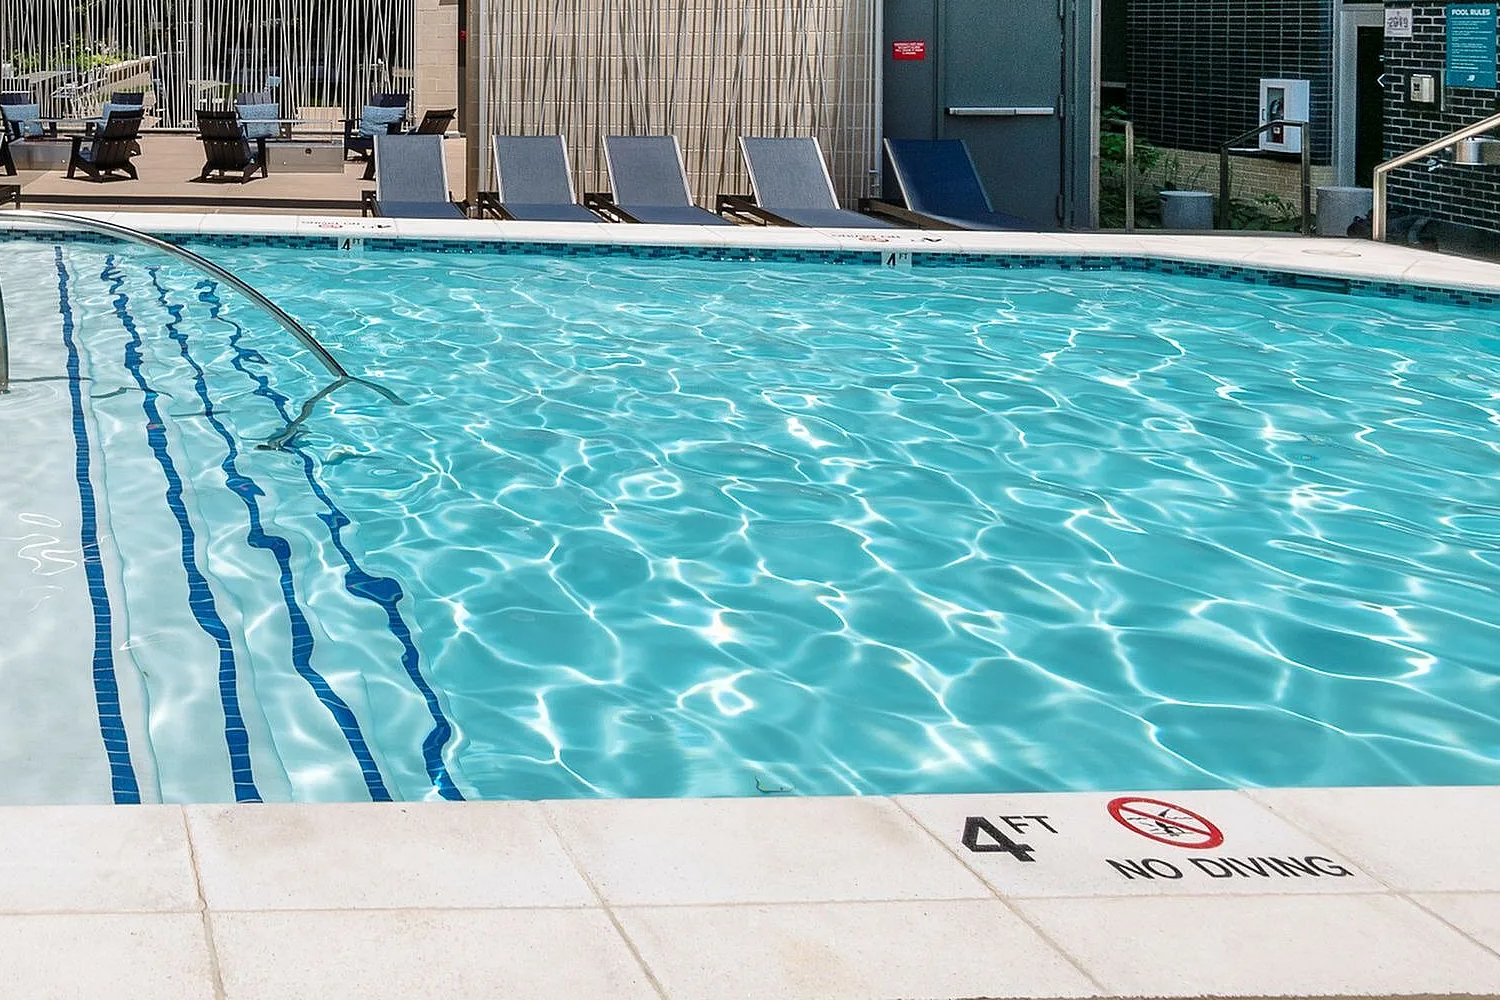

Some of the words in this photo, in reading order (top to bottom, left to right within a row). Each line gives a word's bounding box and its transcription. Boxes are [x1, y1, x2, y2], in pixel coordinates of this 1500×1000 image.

[1451, 8, 1469, 16] POOL
[1470, 8, 1491, 16] RULES
[341, 238, 351, 251] 4
[899, 252, 908, 260] FT
[961, 815, 1037, 863] 4
[999, 814, 1059, 835] FT
[1105, 857, 1184, 881] NO
[1187, 855, 1355, 878] DIVING
